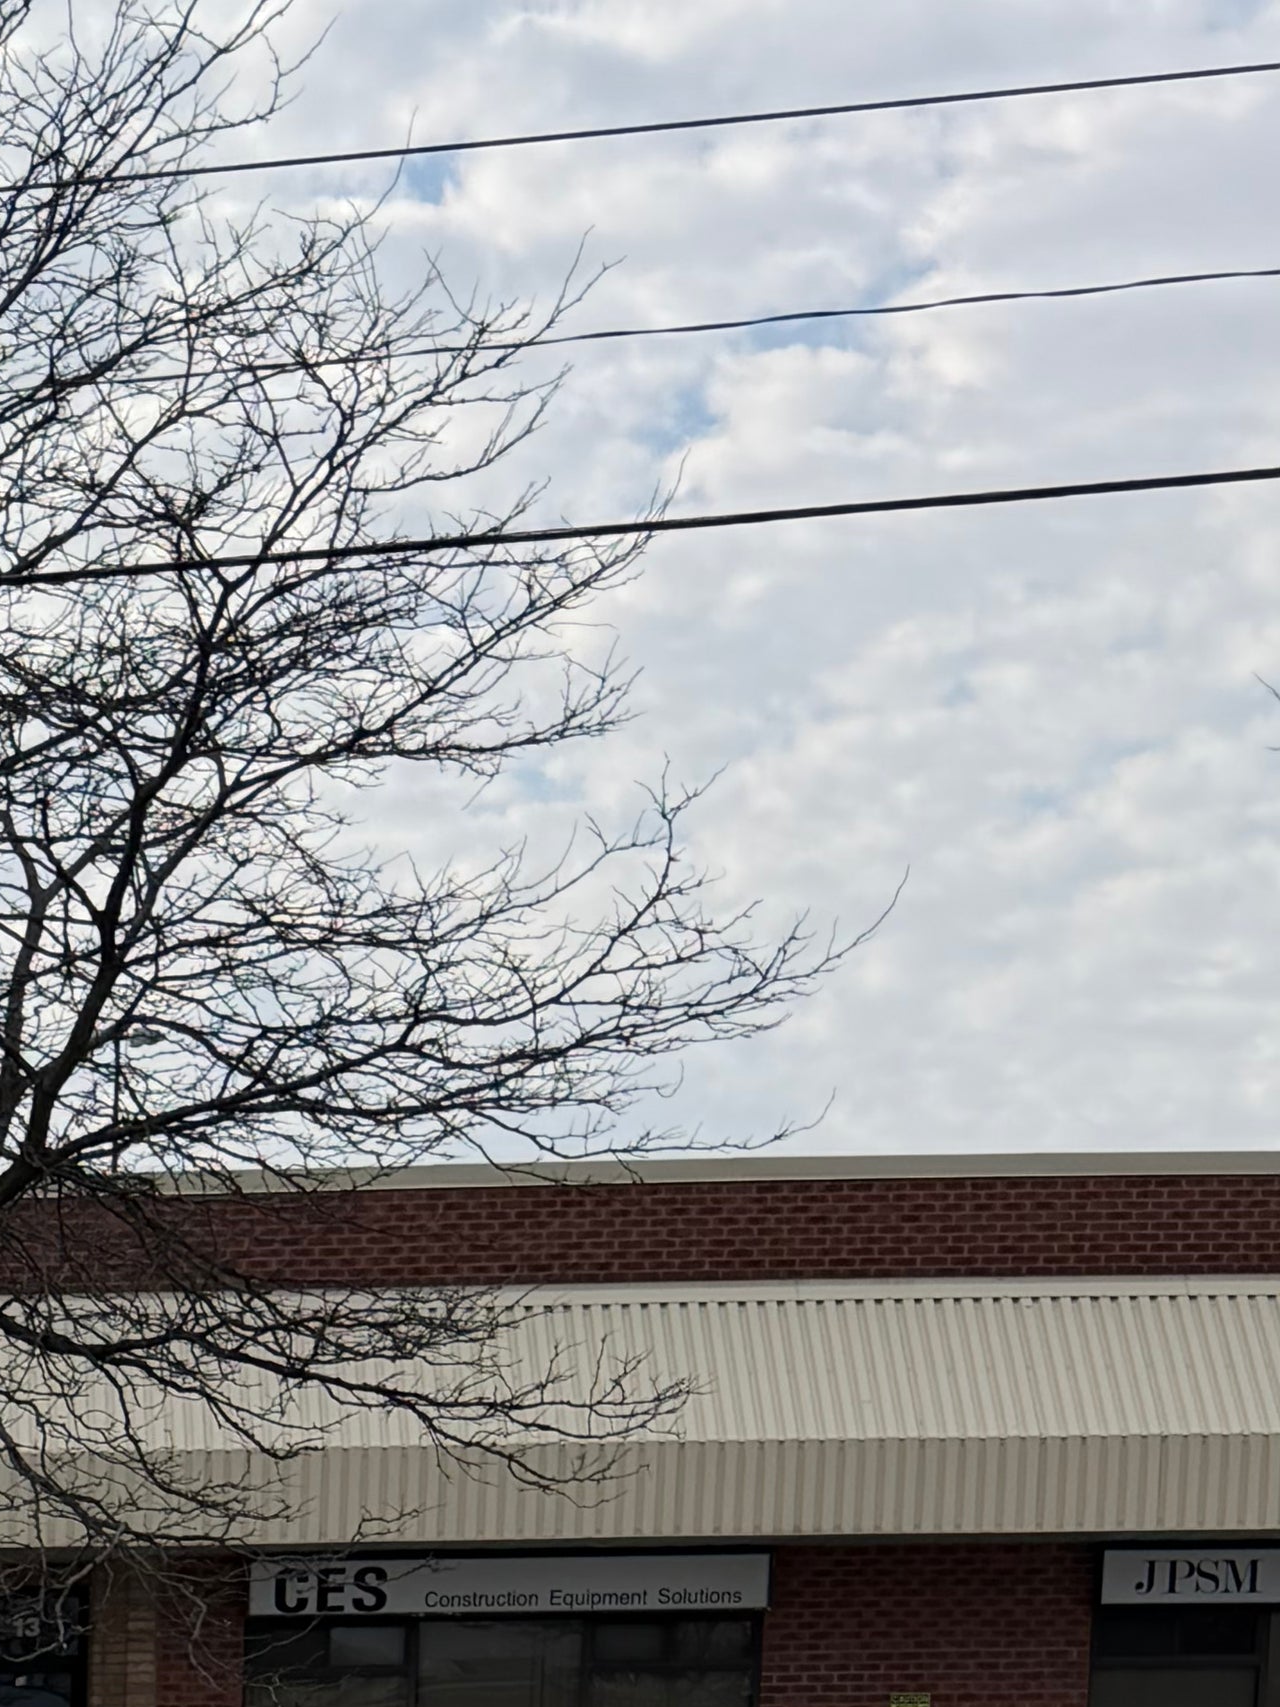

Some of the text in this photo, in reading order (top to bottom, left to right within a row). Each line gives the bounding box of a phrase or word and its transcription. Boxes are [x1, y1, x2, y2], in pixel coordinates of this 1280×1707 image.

[275, 1567, 388, 1613] CES
[1135, 1558, 1263, 1595] JPSM
[425, 1588, 742, 1609] Construction Equipment Solutions
[14, 1618, 40, 1638] 13
